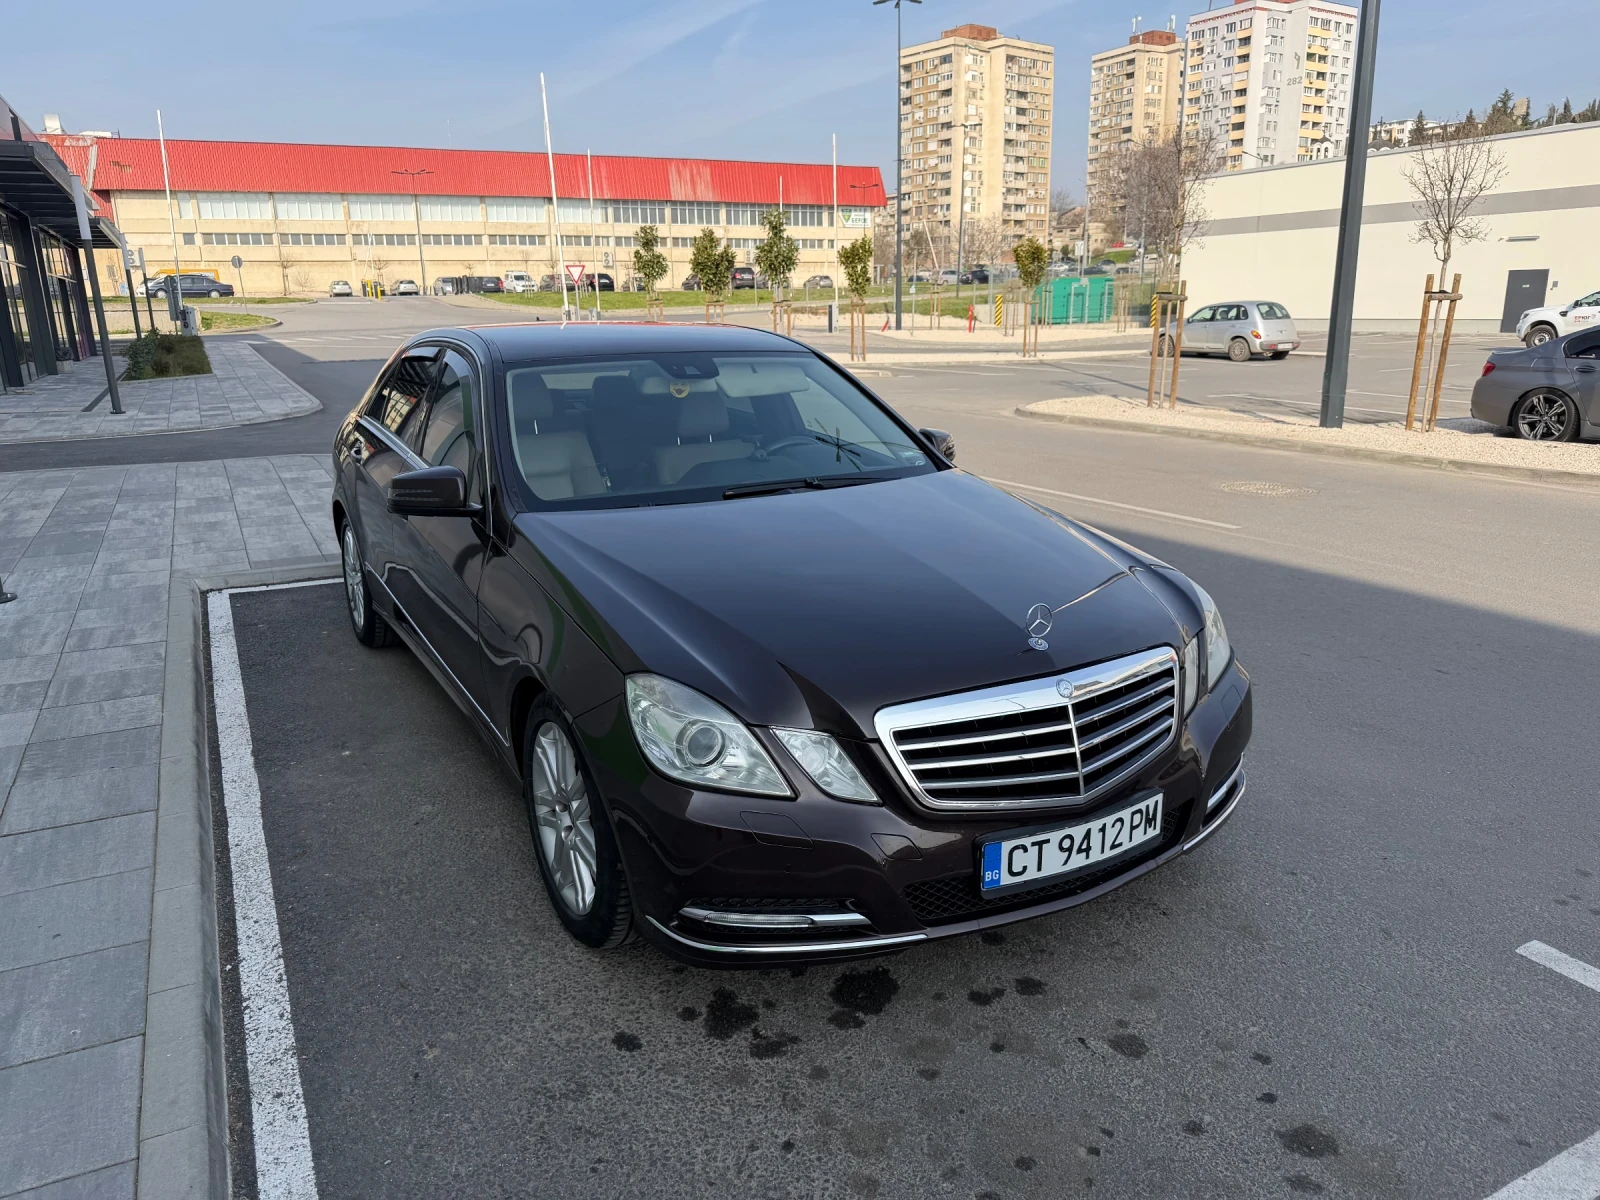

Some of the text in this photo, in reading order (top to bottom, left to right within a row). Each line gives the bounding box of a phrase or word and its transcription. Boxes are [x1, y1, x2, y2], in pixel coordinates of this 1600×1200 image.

[1286, 76, 1303, 86] 282
[1007, 800, 1159, 877] CT 9412 PM
[985, 869, 1000, 882] BG
